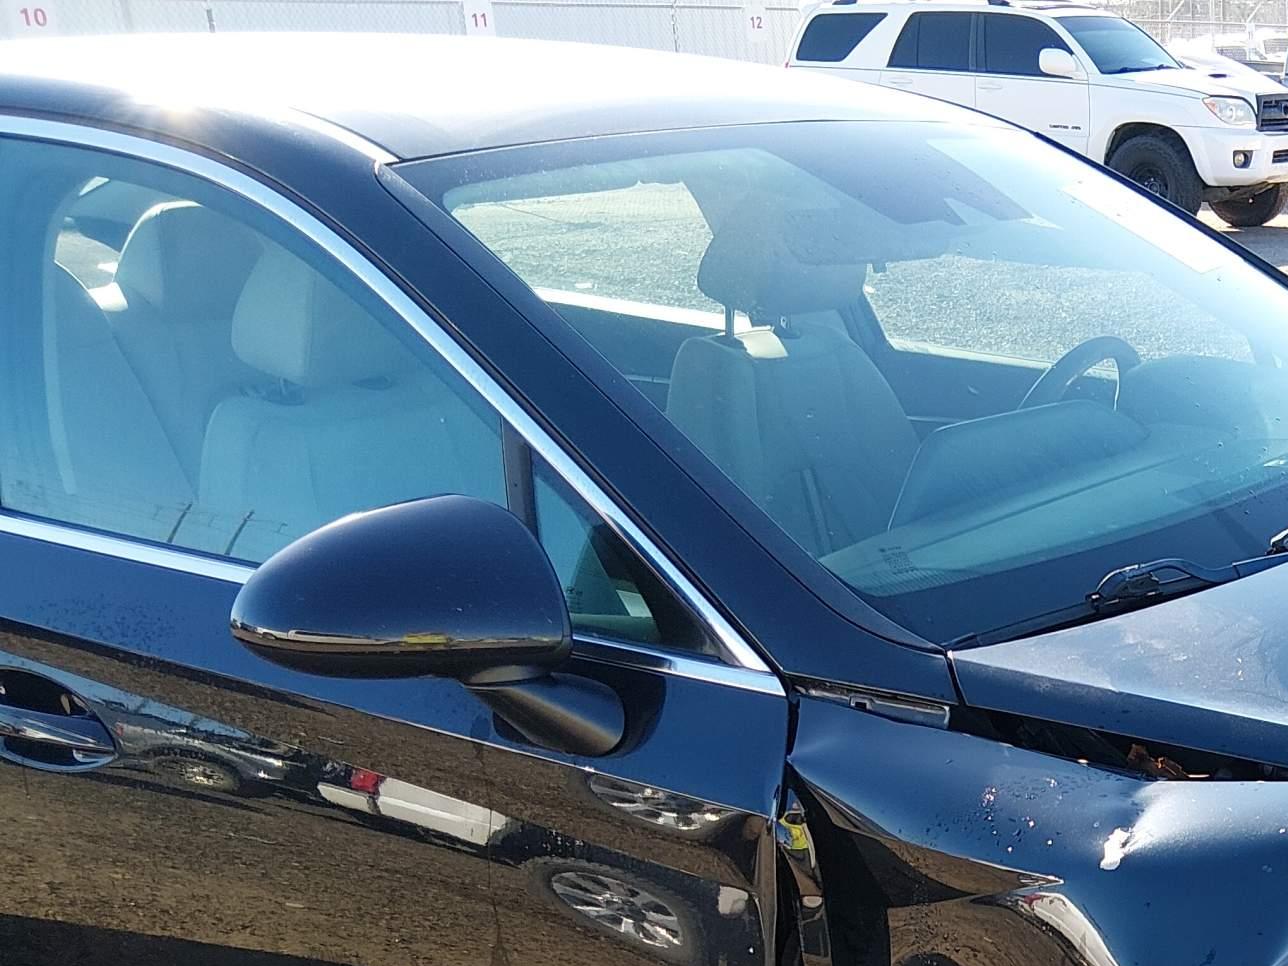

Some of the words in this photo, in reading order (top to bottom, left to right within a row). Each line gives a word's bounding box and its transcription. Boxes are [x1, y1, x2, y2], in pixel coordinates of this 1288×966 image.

[20, 8, 47, 27] 10
[471, 13, 487, 28] 11
[750, 16, 763, 29] 12
